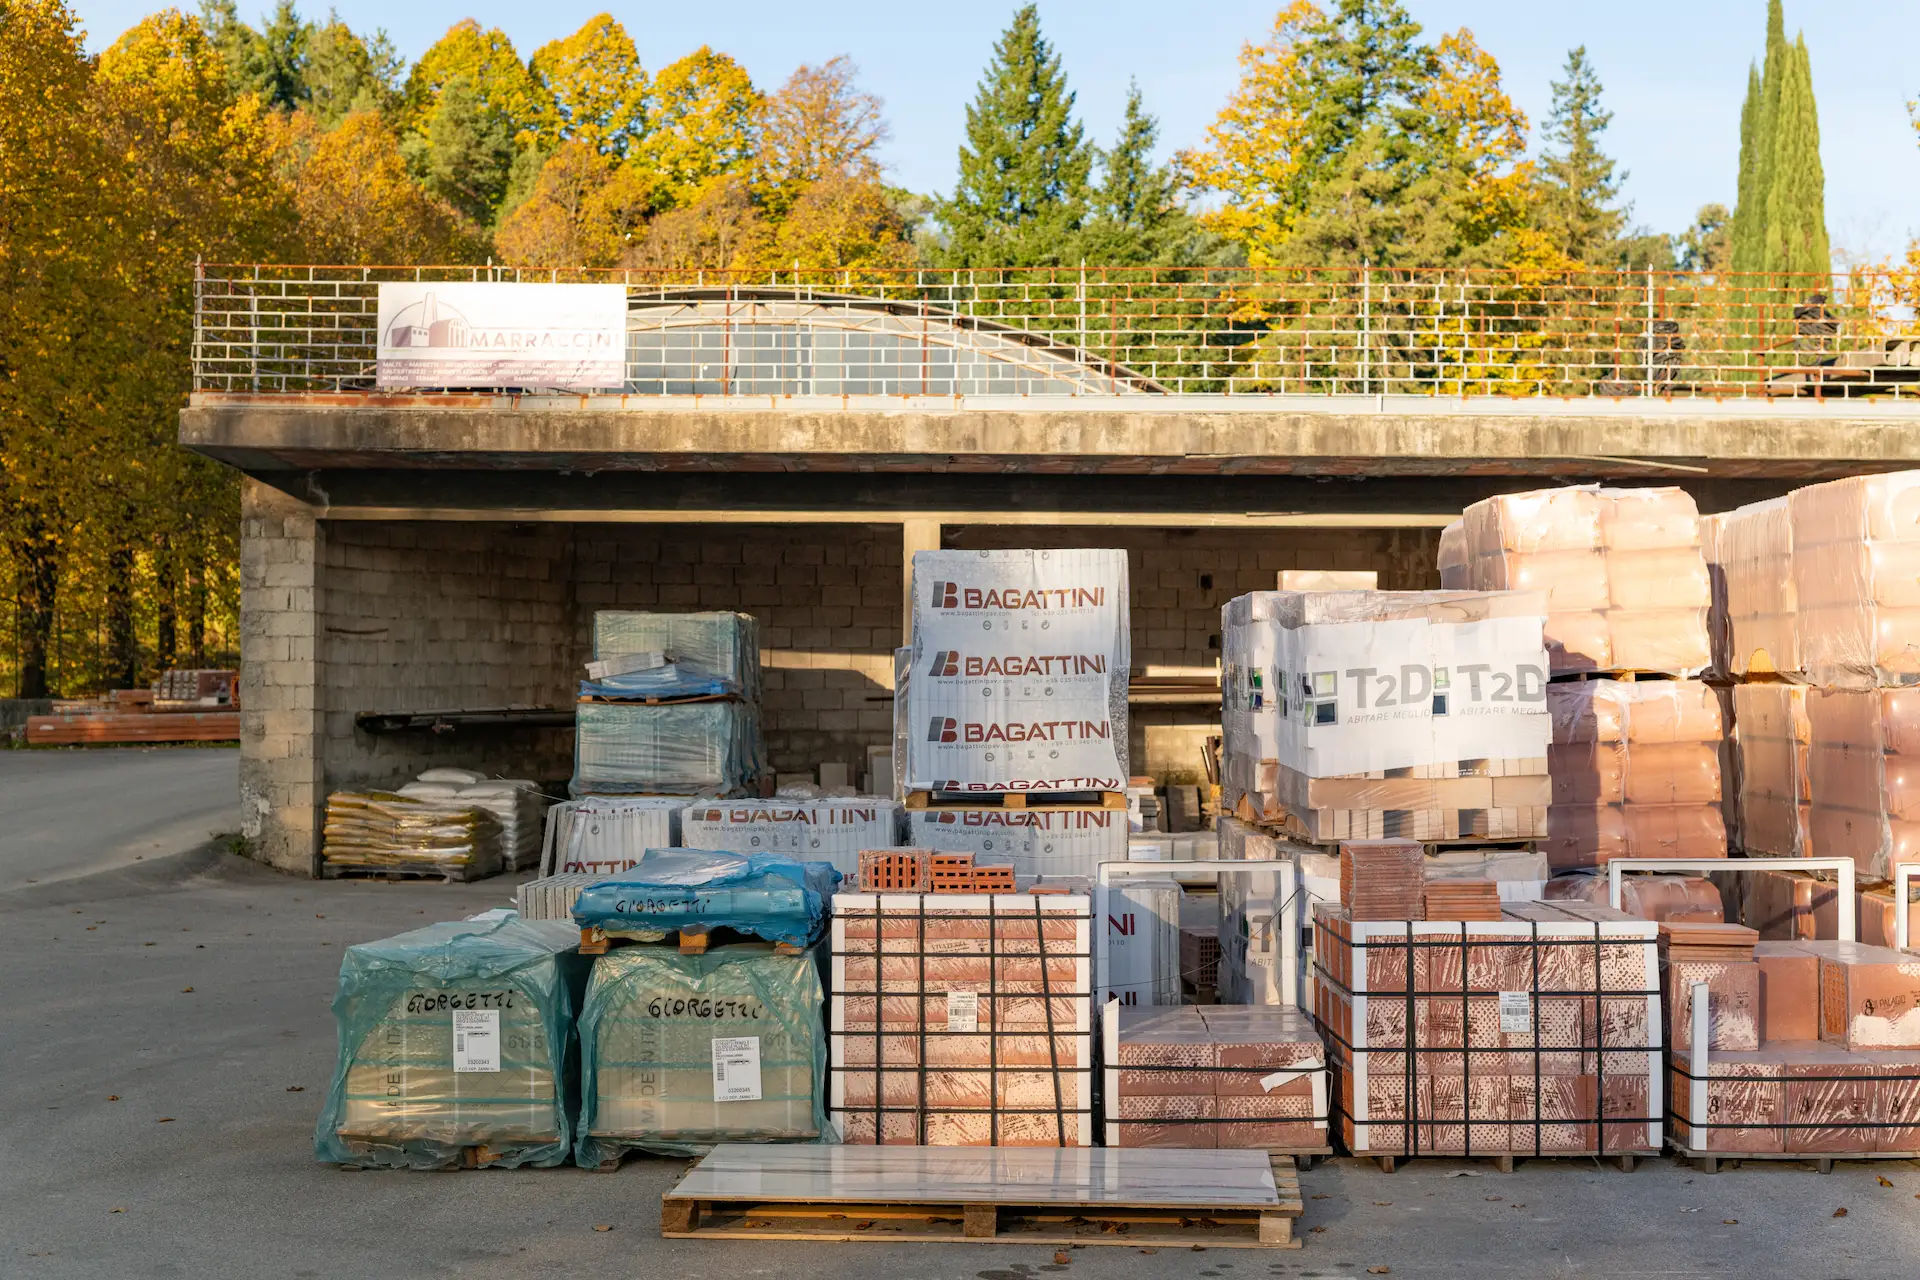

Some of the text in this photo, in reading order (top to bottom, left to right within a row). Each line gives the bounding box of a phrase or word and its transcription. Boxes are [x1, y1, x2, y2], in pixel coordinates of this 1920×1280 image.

[470, 332, 619, 347] MARRACCINI
[964, 587, 1105, 609] BAGATTINI
[965, 654, 1106, 676] BAGATTINI
[1346, 664, 1433, 709] T2D
[1457, 663, 1546, 703] T2D
[1347, 708, 1431, 725] ABITARE MEGLIO
[1460, 706, 1506, 716] ABITARE
[964, 721, 1110, 743] BAGATTINI
[967, 777, 1120, 791] BAGATTINI
[729, 808, 876, 825] BAGATTINI
[963, 811, 1111, 830] BAGATTINI
